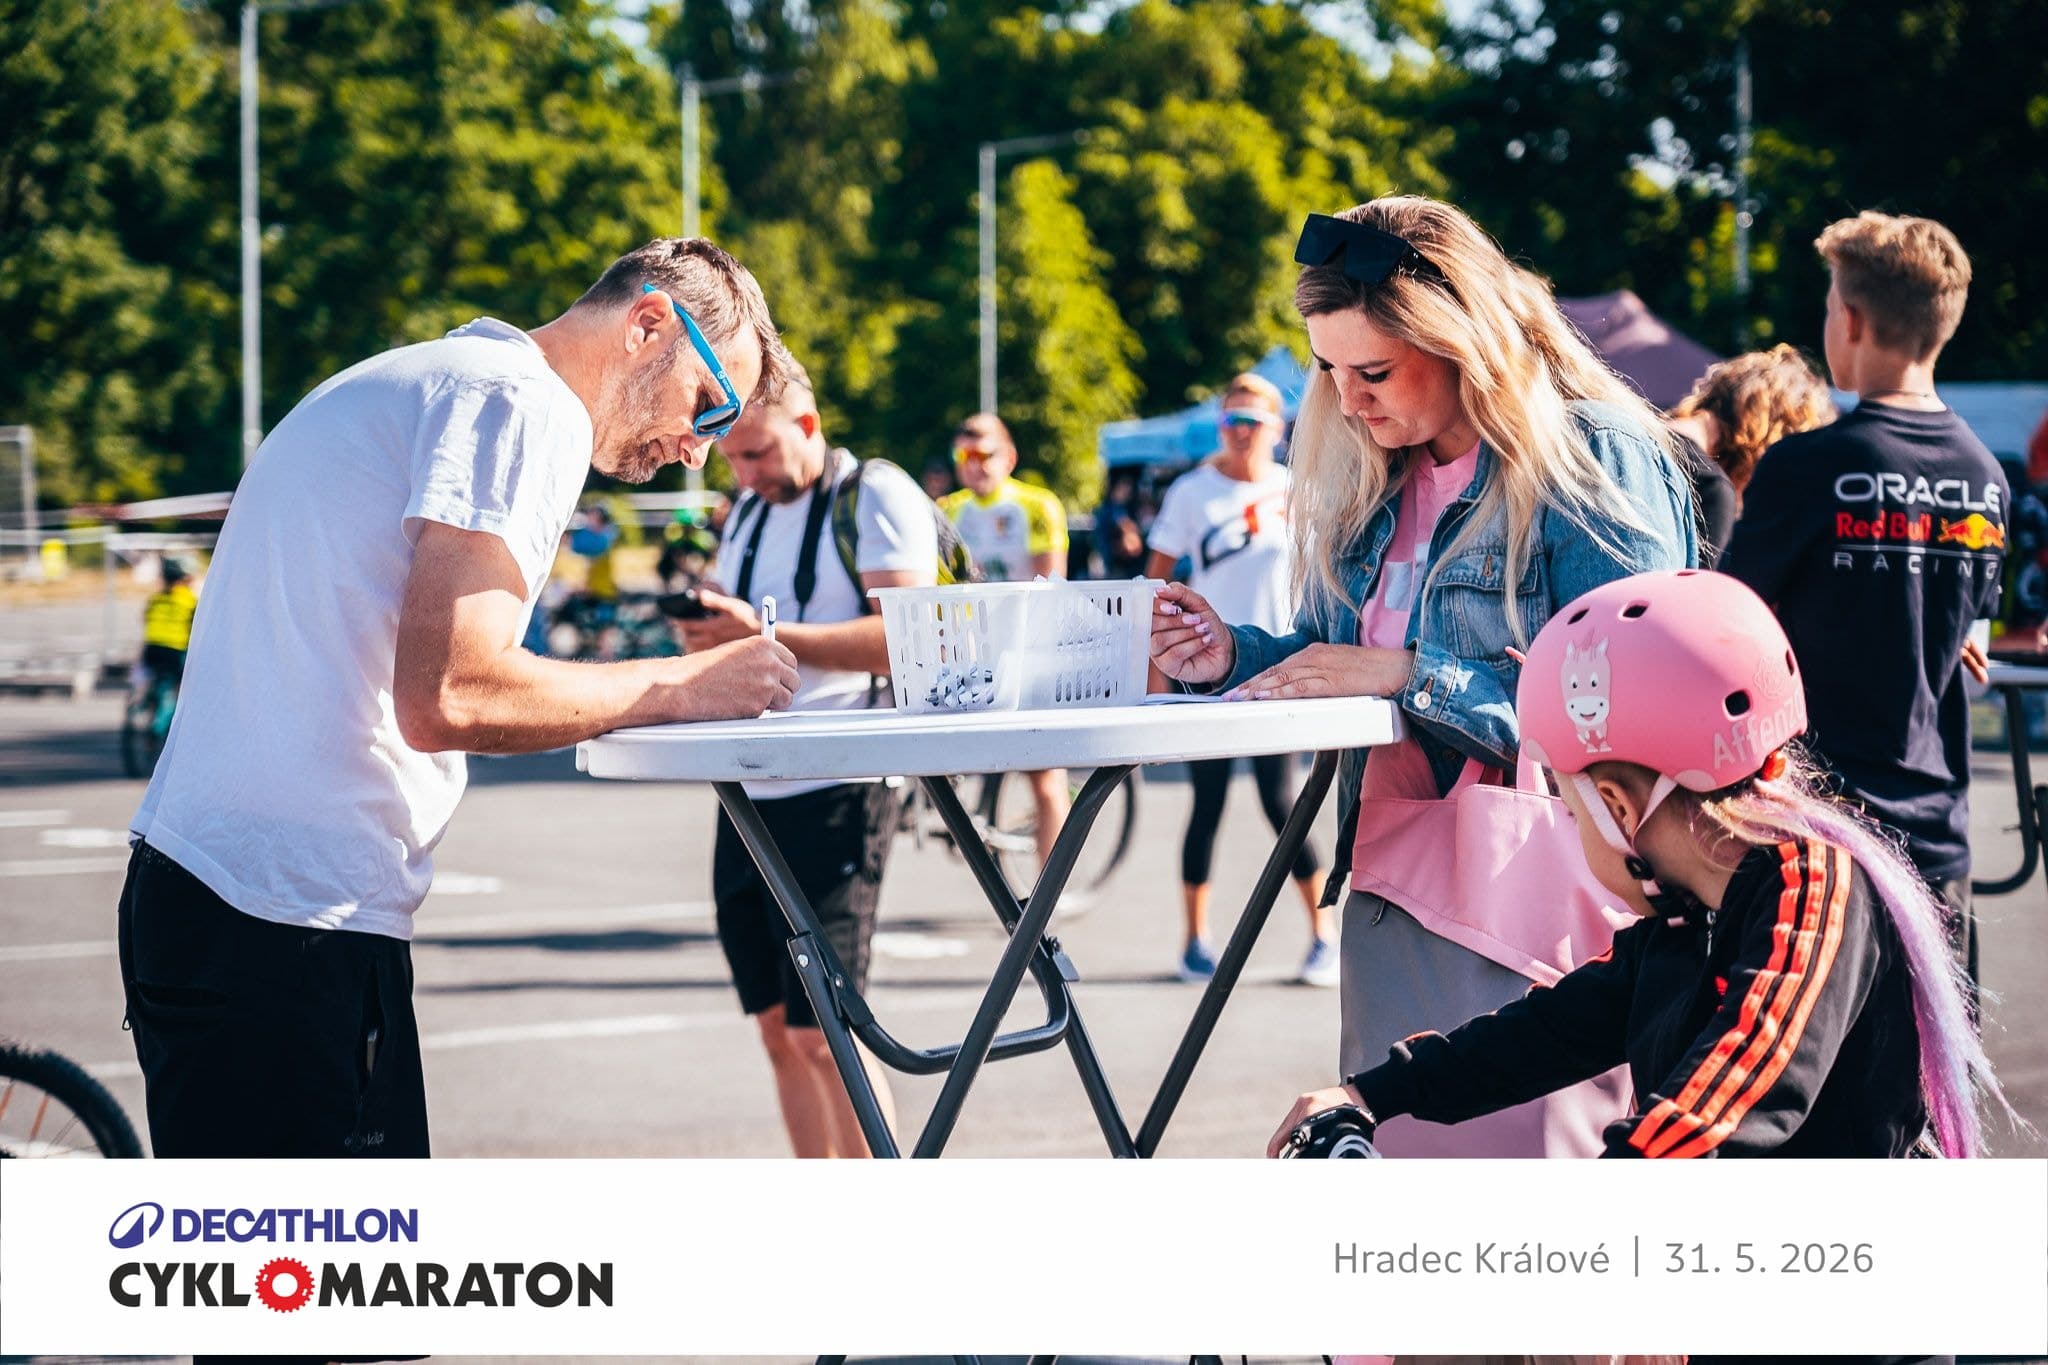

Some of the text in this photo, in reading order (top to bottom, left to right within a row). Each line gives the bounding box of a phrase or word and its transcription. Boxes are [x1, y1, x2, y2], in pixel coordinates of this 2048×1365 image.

[1834, 472, 2001, 513] ORACLE
[1836, 509, 1932, 542] Red Bull
[1833, 551, 1999, 580] RACING
